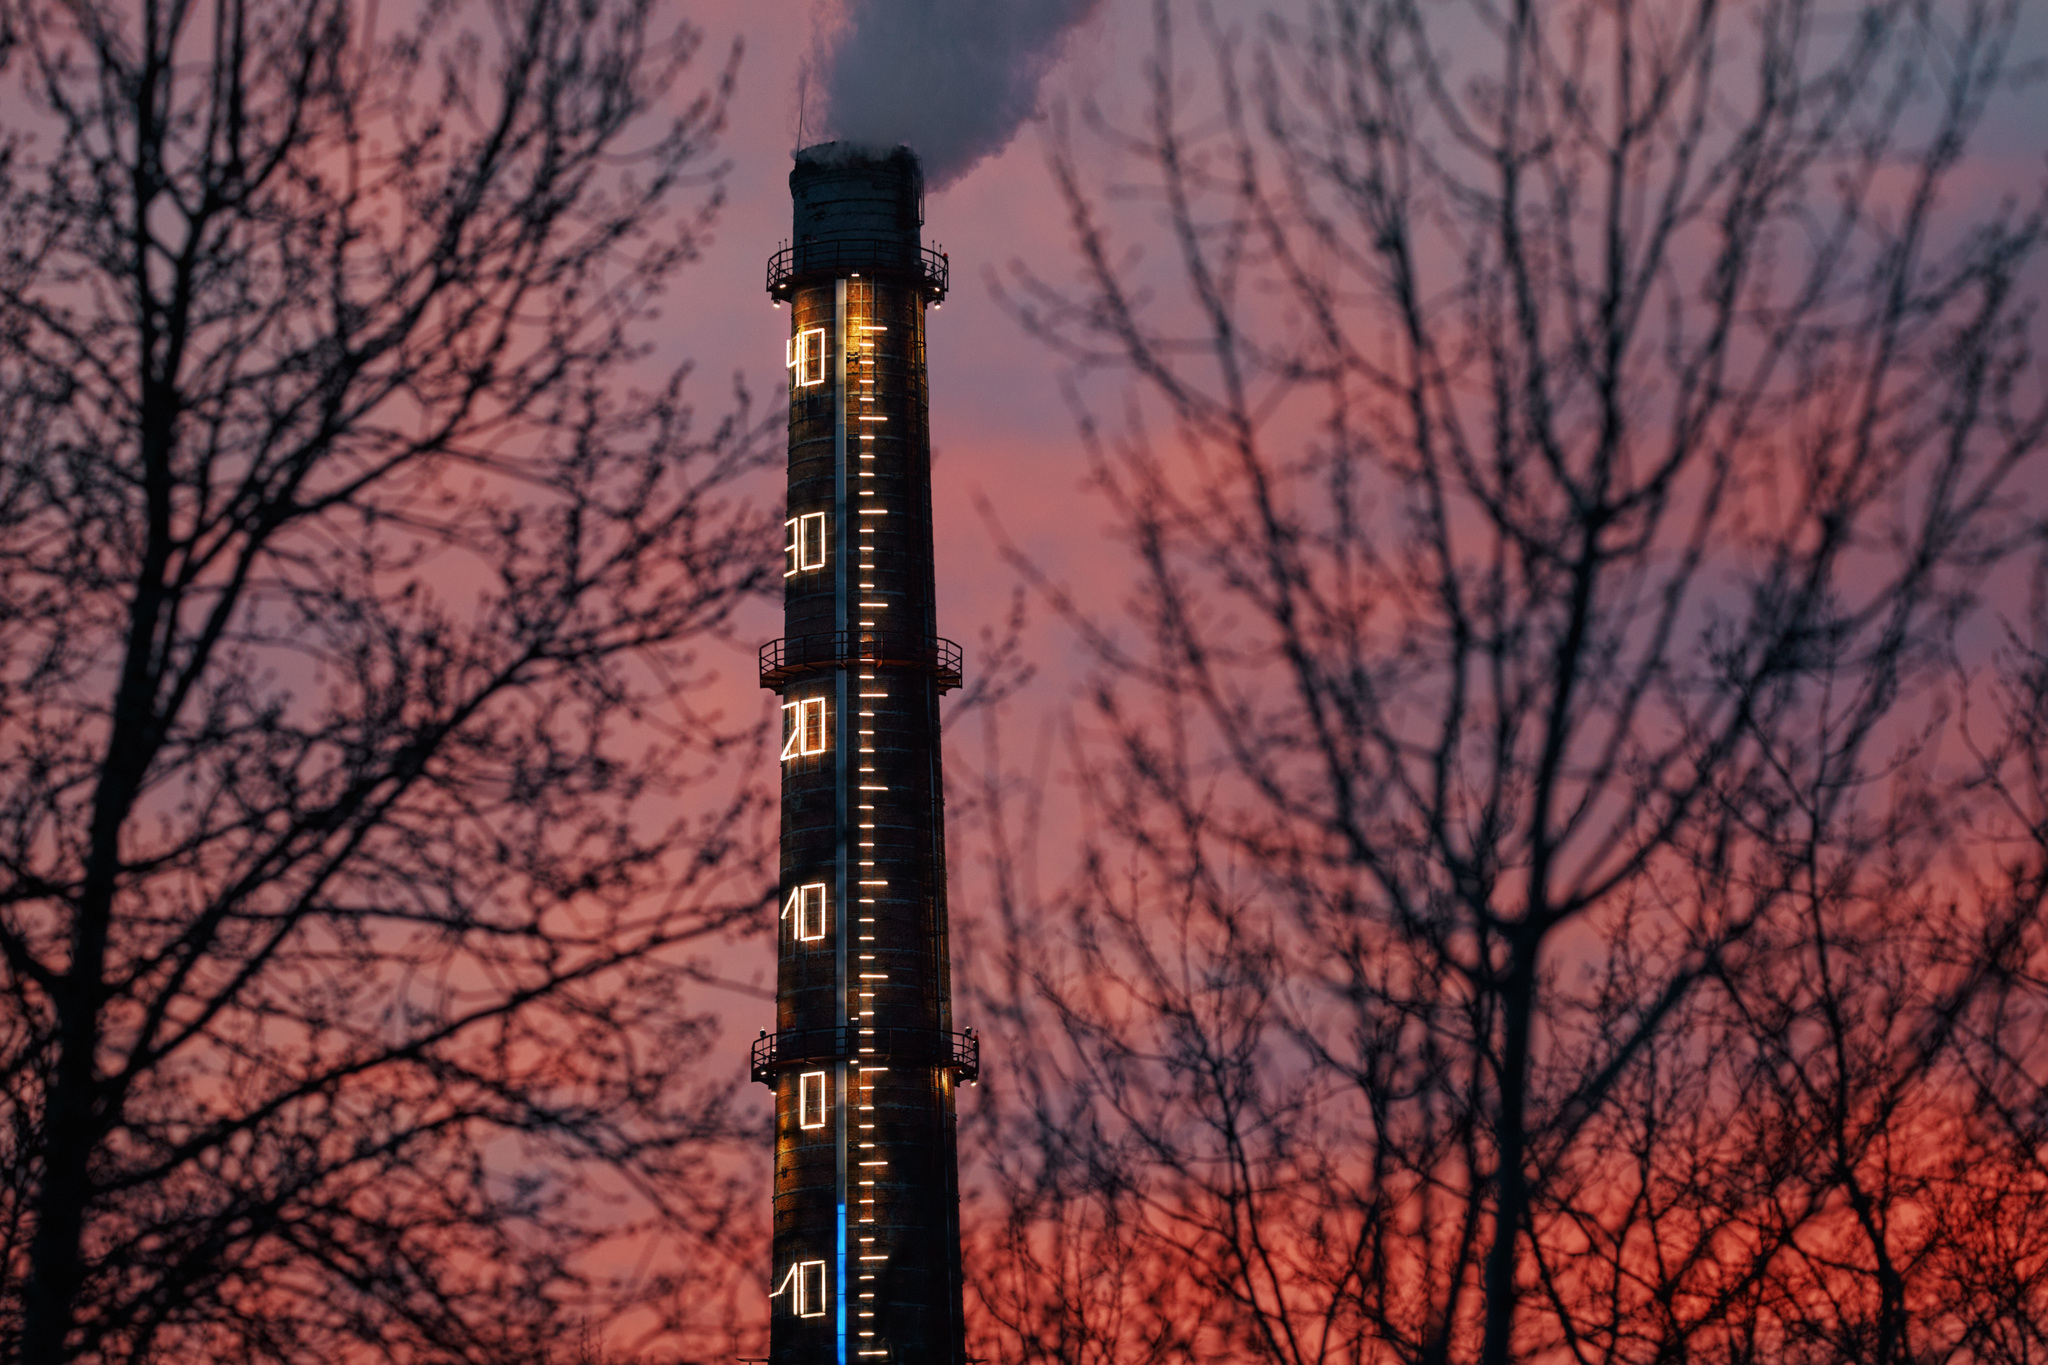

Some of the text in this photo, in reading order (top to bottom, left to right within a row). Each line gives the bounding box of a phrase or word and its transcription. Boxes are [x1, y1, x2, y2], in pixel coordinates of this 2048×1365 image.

[786, 327, 825, 388] 40
[783, 511, 826, 577] 30
[780, 696, 826, 761] 20
[781, 883, 826, 941] 10
[800, 1071, 826, 1130] 0
